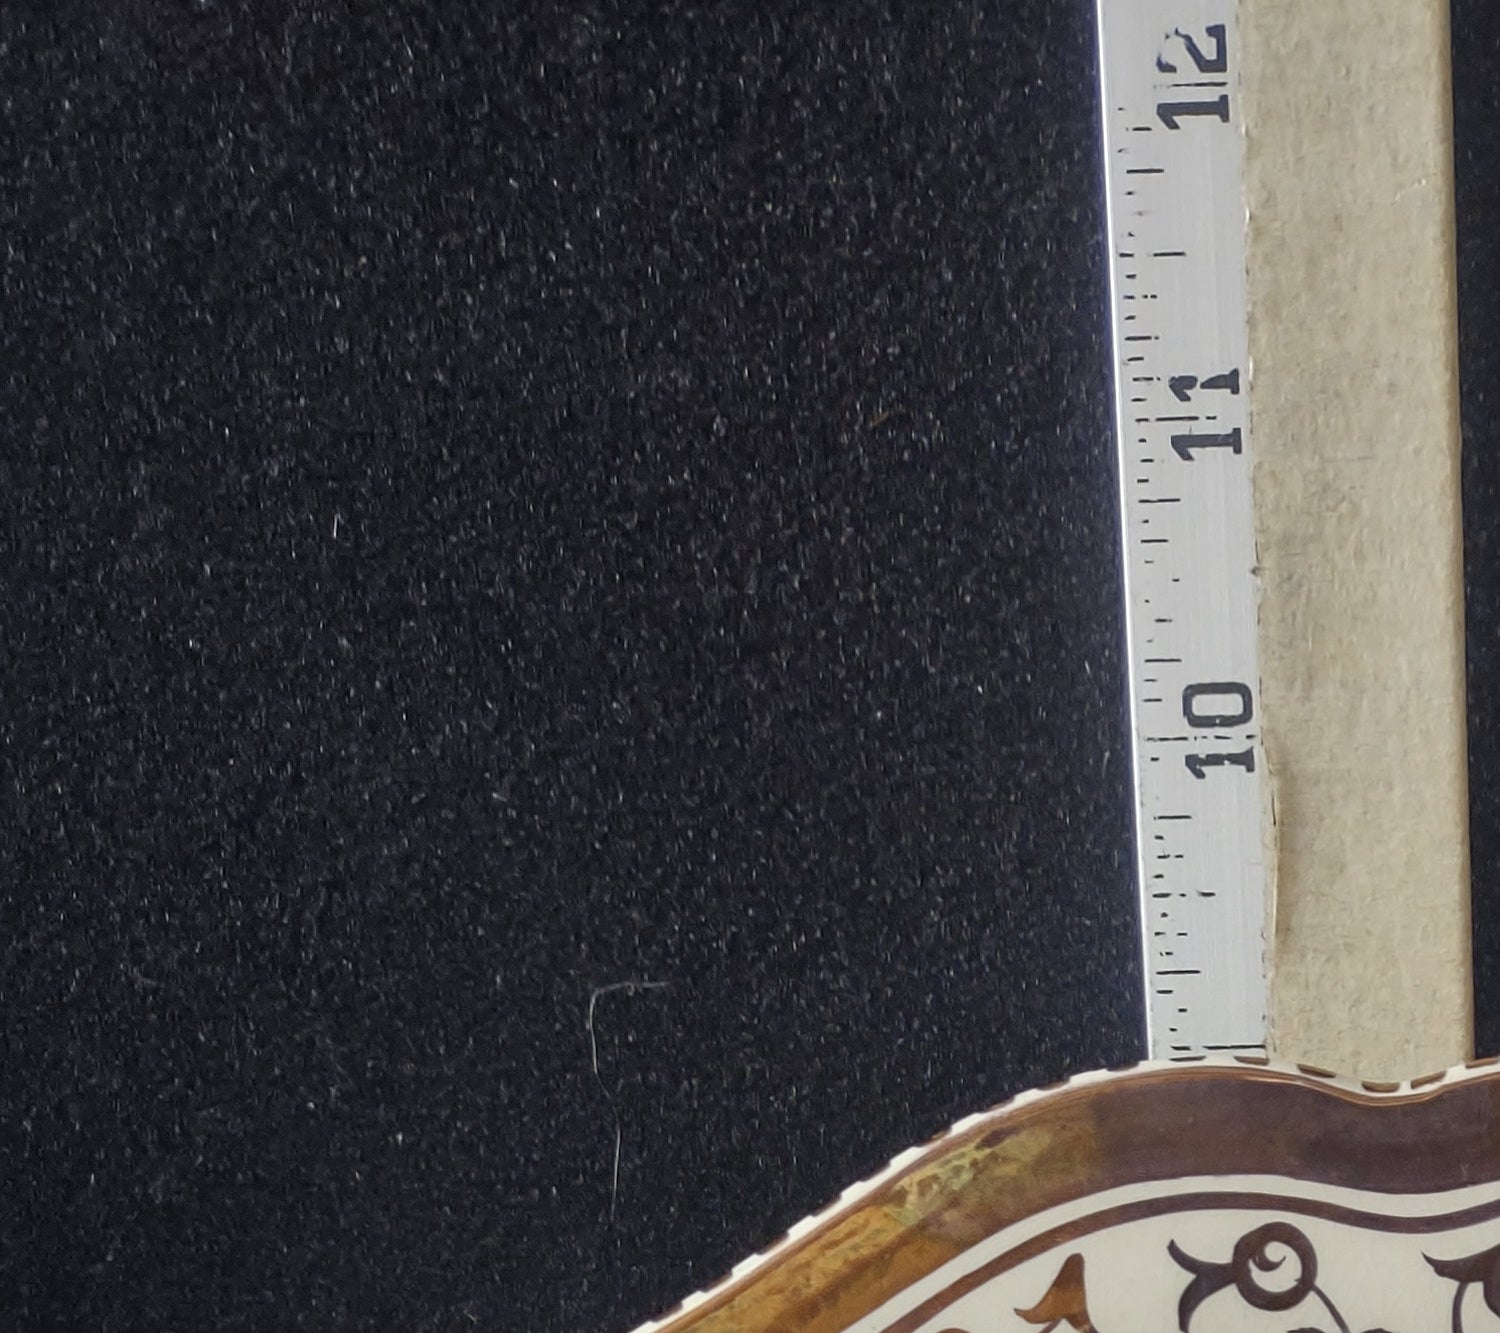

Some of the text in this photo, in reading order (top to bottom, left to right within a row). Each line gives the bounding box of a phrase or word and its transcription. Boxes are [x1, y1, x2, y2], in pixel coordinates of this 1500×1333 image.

[1156, 24, 1230, 130] 12
[1168, 368, 1243, 461] 11
[1182, 682, 1255, 779] 10
